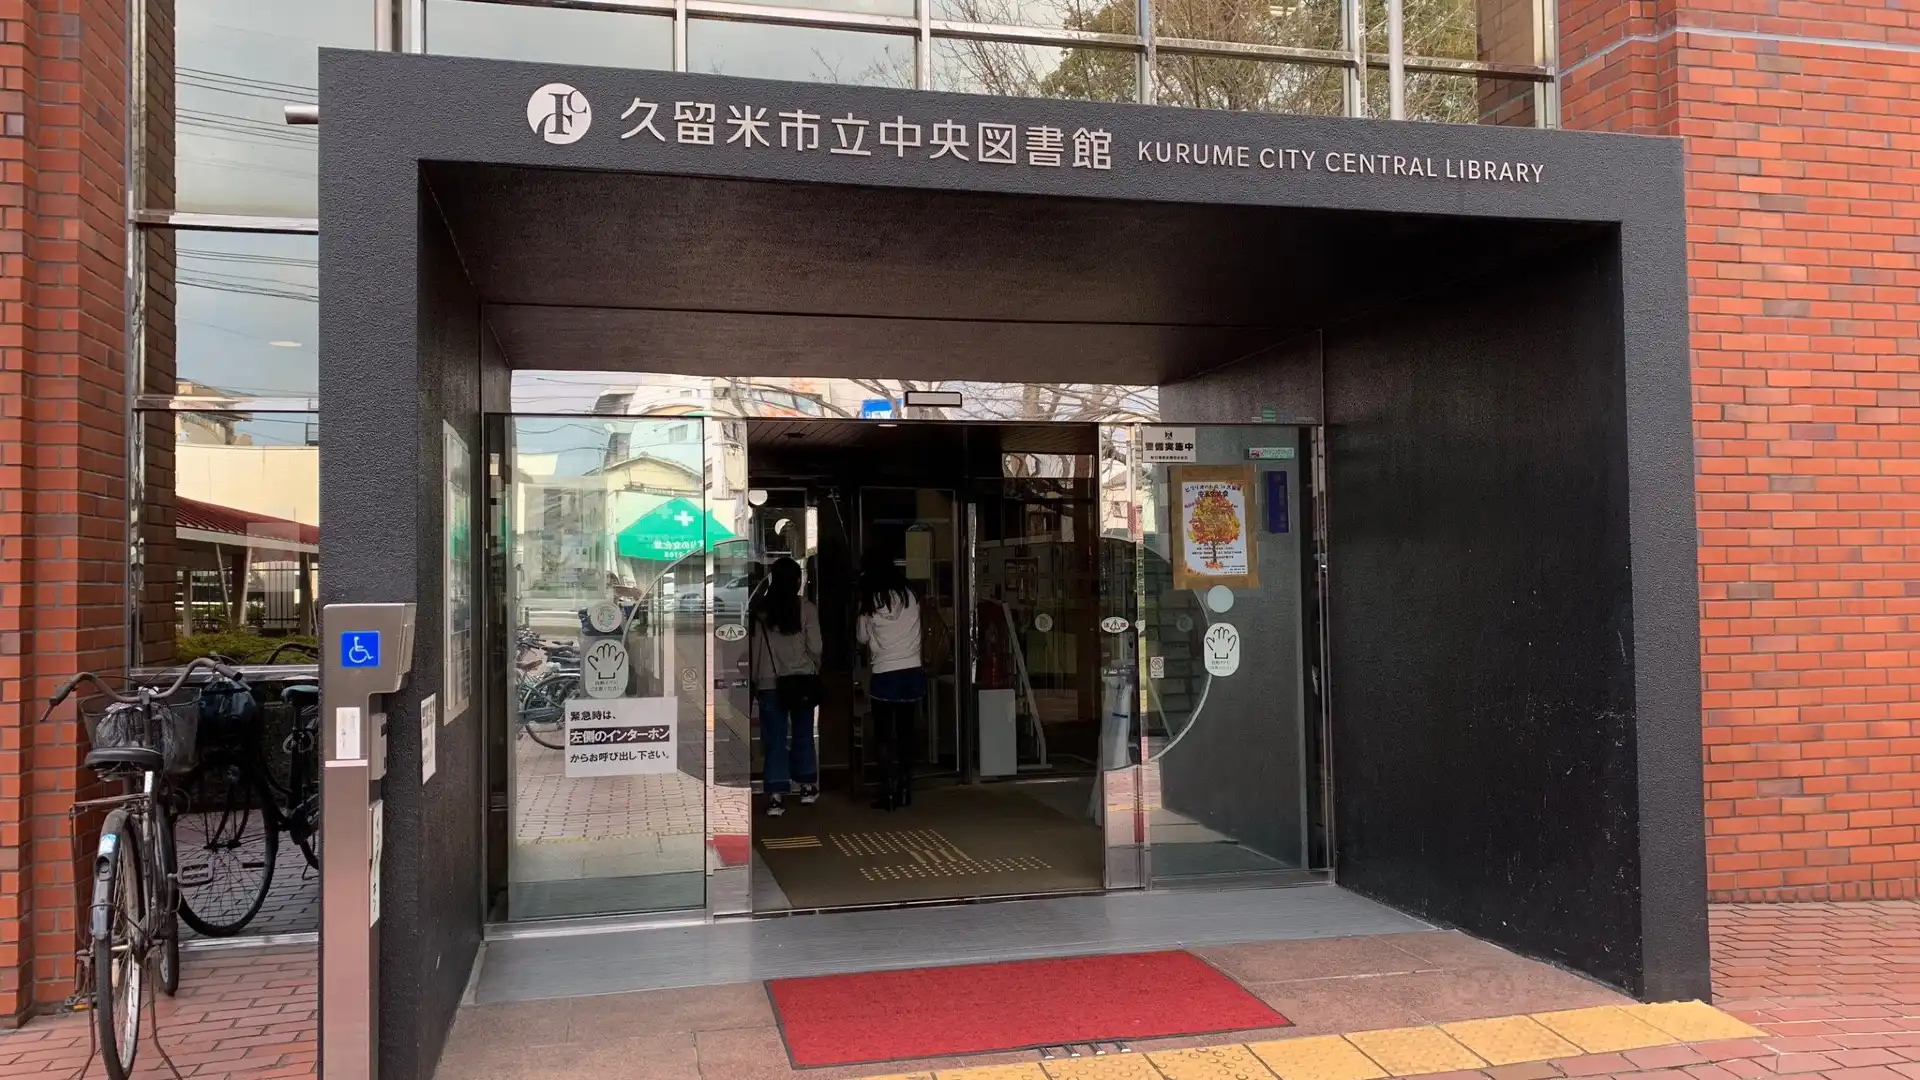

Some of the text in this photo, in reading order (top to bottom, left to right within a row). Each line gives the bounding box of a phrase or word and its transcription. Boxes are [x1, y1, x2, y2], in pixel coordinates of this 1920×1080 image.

[620, 97, 1113, 171] 久留米市立中央図書館
[1137, 141, 1544, 184] KURUME CITY CENTRAL LIBRARY
[570, 710, 617, 721] 緊急時は、
[570, 727, 670, 743] 左側のインターホン
[570, 750, 670, 763] からお呼び出し下さい。
